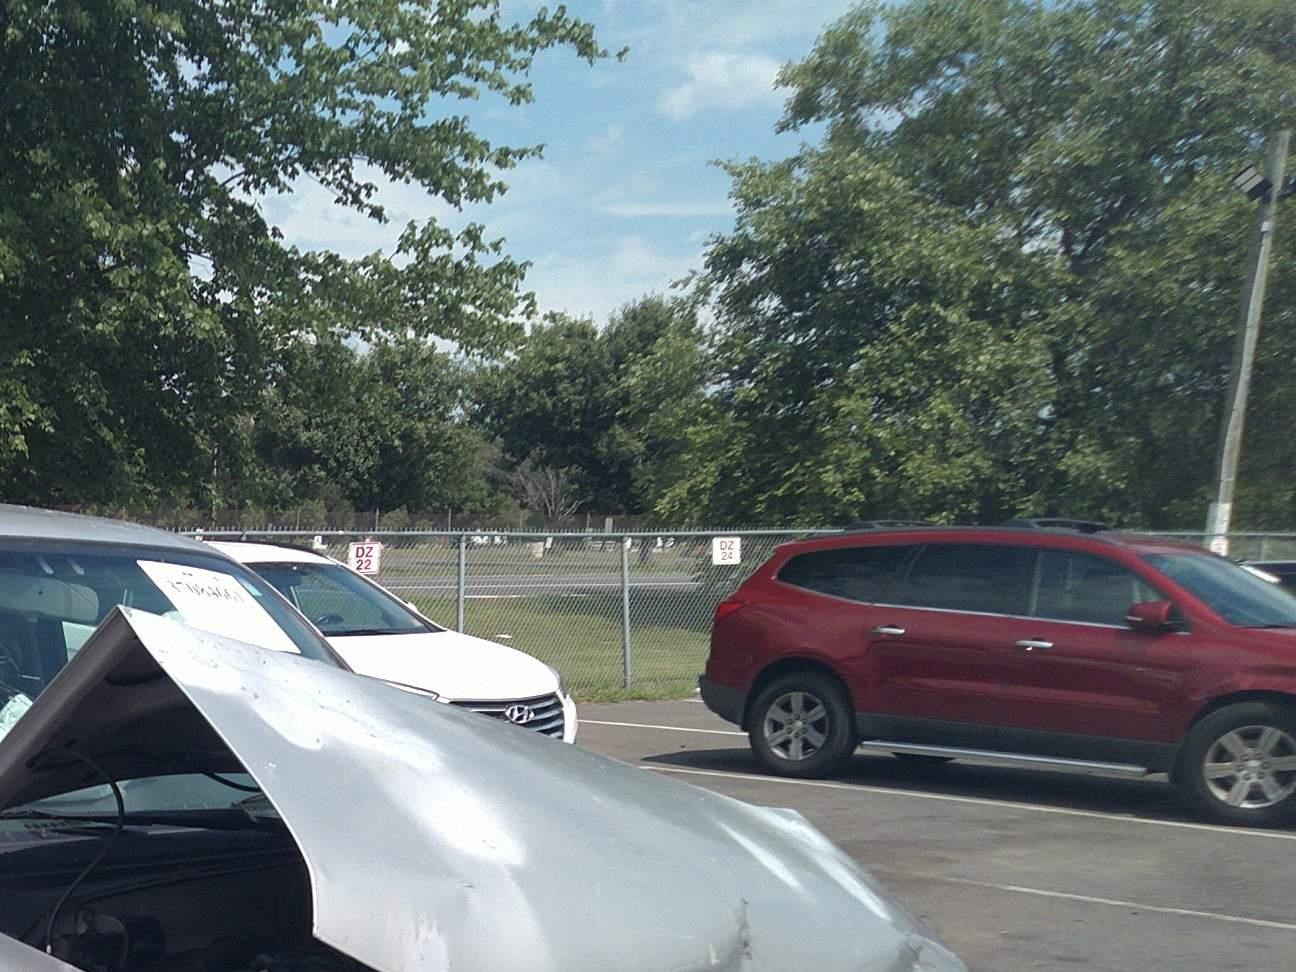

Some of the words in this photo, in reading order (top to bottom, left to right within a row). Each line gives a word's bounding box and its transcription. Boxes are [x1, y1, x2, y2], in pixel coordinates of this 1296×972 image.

[719, 540, 735, 551] DZ
[355, 546, 374, 559] DZ
[355, 559, 372, 571] 22
